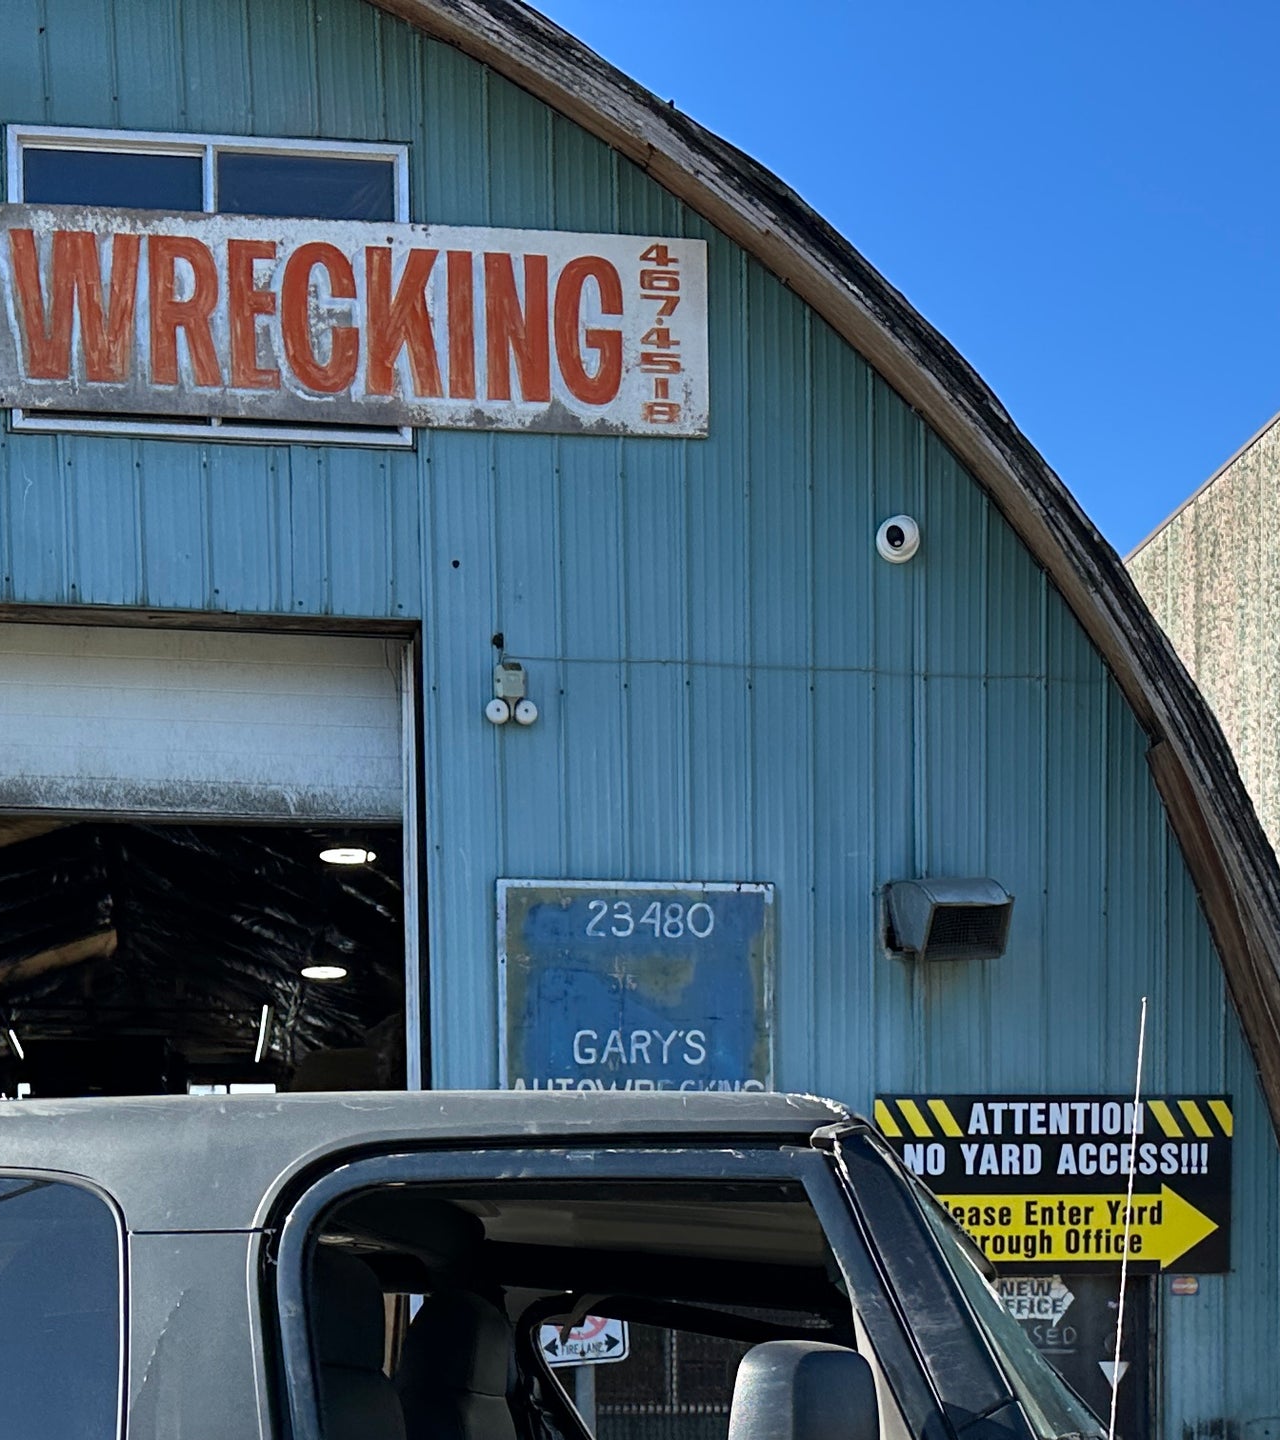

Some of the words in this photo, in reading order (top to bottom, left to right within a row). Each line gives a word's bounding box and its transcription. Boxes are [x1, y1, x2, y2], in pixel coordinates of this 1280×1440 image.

[8, 227, 625, 406] WRECKING
[585, 898, 716, 939] 23480
[572, 1028, 708, 1066] GARY'S
[966, 1101, 1145, 1136] ATTENTION
[902, 1142, 947, 1176] NO
[959, 1142, 1043, 1176] YARD
[1056, 1142, 1210, 1175] ACCESS!!!
[944, 1200, 1013, 1226] ease
[1024, 1200, 1095, 1226] Enter
[1106, 1200, 1163, 1225] Yard
[1065, 1228, 1144, 1255] Office
[998, 1279, 1052, 1297] NEW
[1004, 1297, 1064, 1315] FFICE
